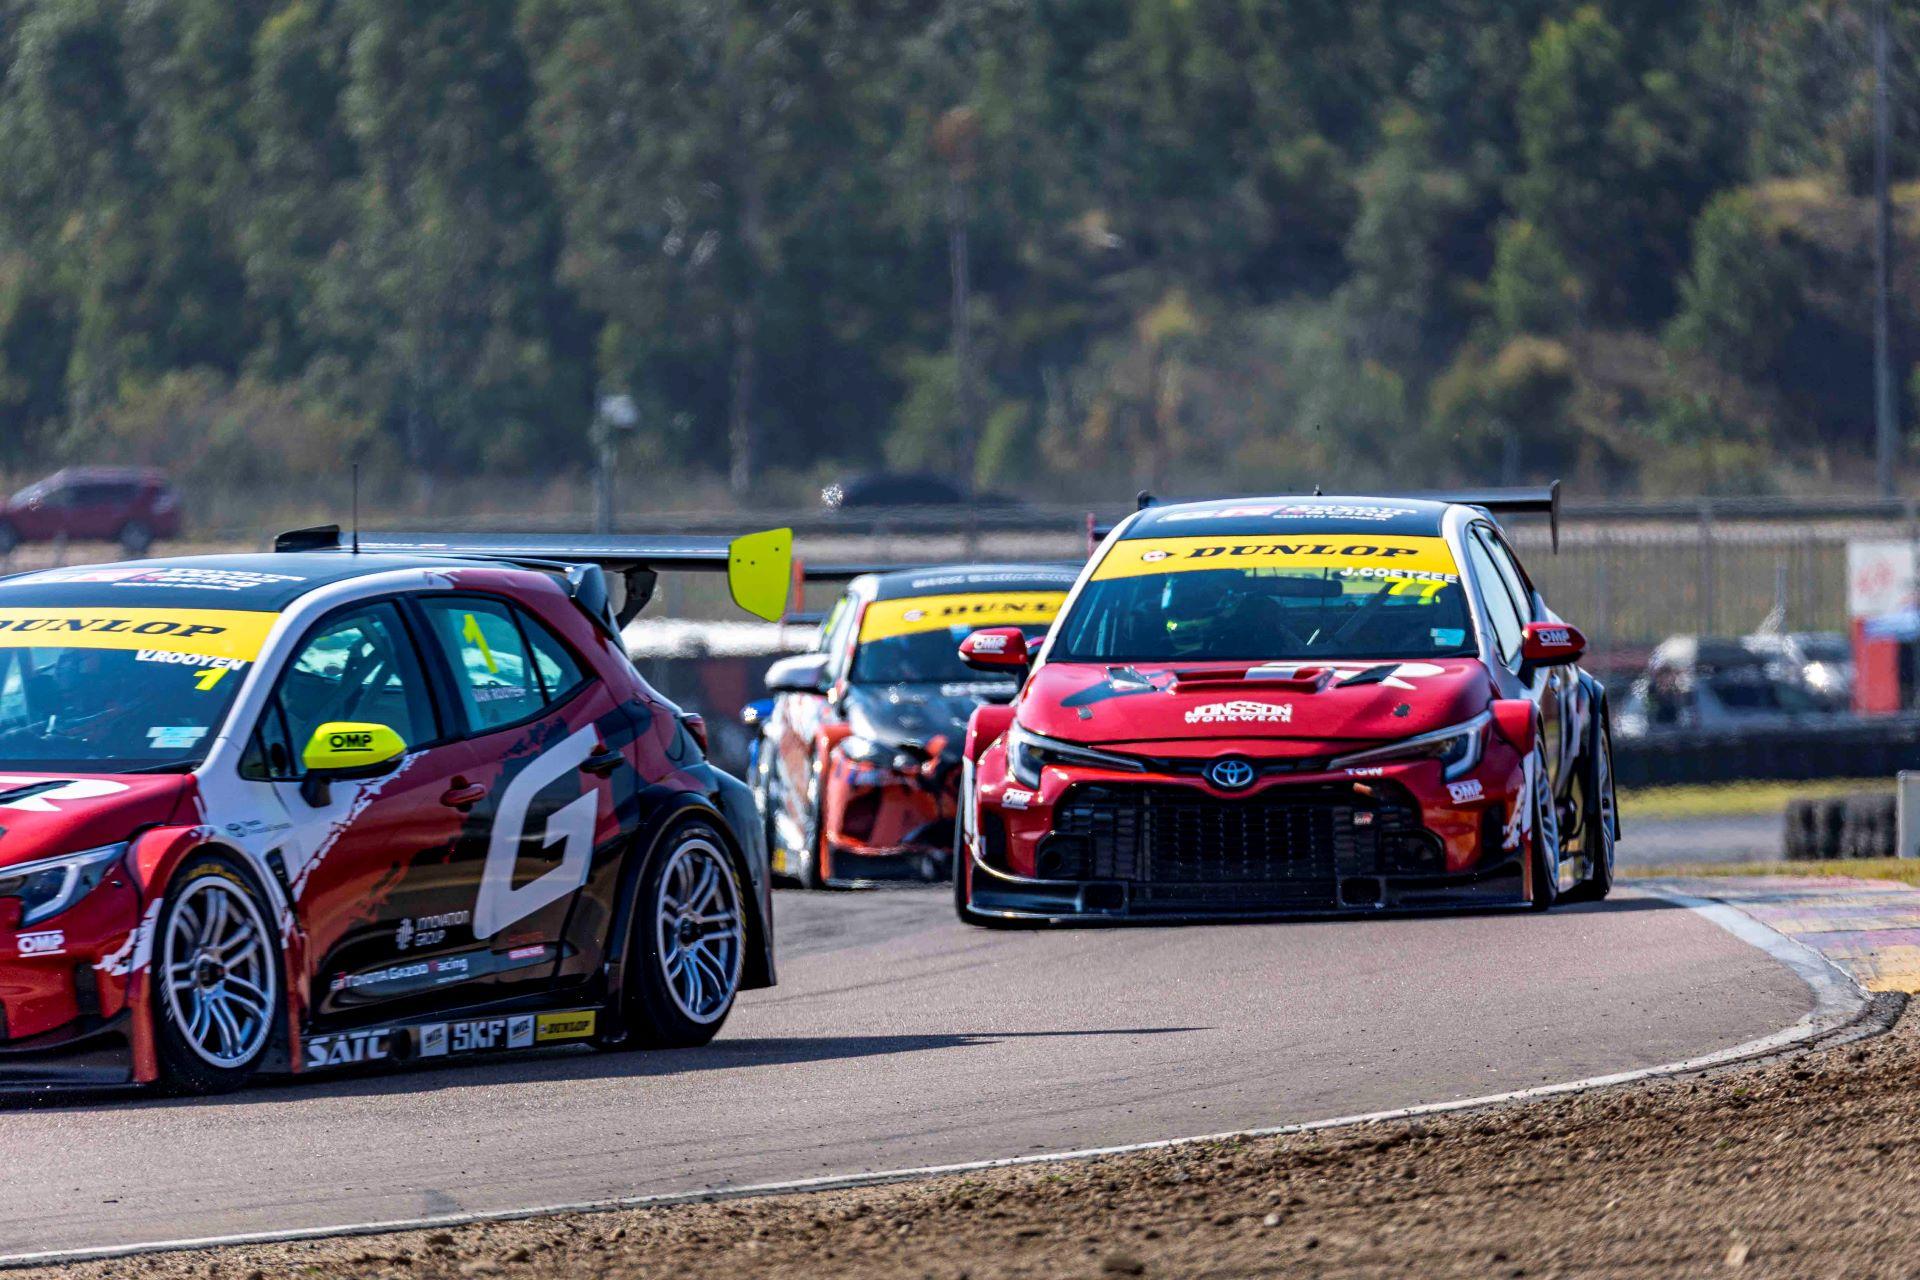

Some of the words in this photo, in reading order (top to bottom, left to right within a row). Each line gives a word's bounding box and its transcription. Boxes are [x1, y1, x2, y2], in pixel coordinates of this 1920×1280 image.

[1186, 544, 1419, 558] DUNLOP
[1340, 566, 1460, 584] J.COETZEE
[1383, 575, 1448, 601] 77
[461, 613, 499, 675] 1
[1538, 628, 1570, 644] OMP
[193, 667, 230, 691] 1
[1185, 700, 1292, 717] JONSSON
[1184, 714, 1292, 724] WORKWEAR
[329, 733, 373, 749] OMP
[1449, 781, 1483, 801] OMP
[17, 933, 65, 954] OMP
[453, 1019, 506, 1051] SKF
[307, 1027, 392, 1068] SATC
